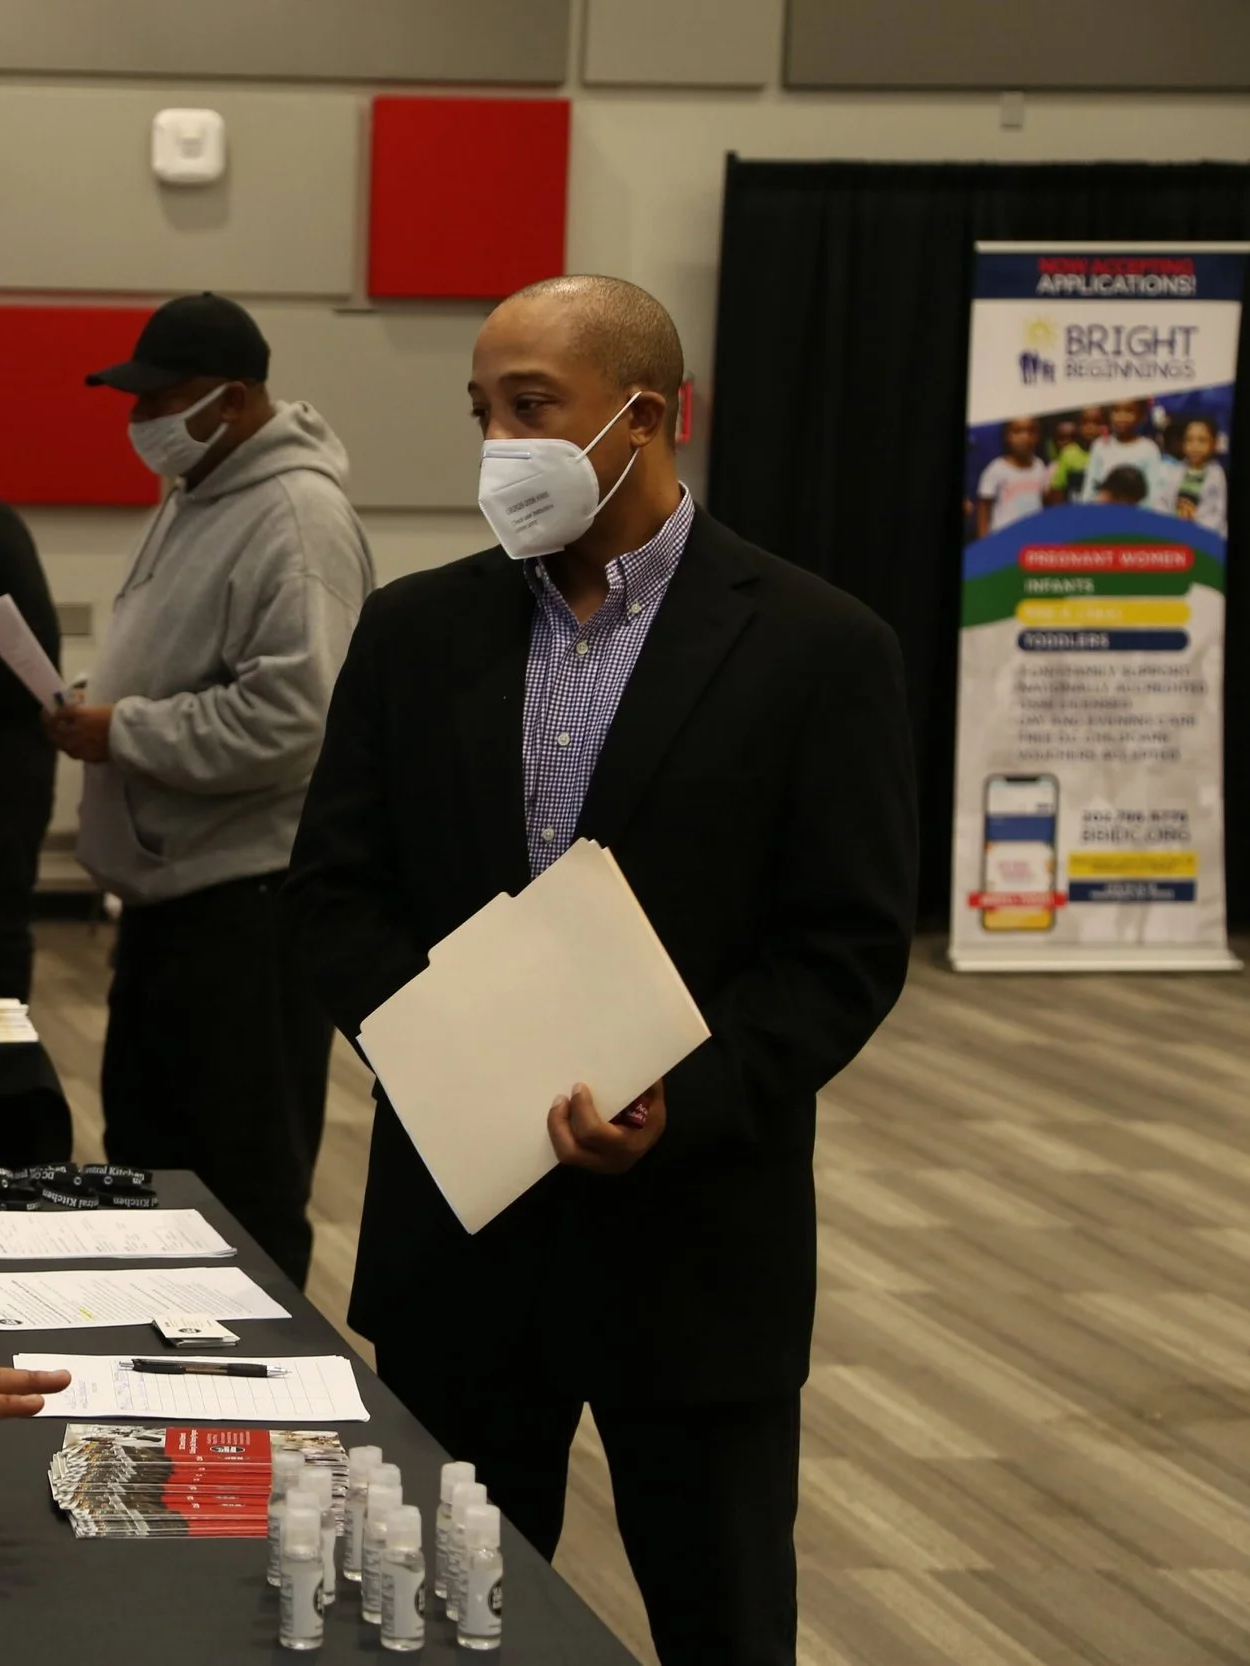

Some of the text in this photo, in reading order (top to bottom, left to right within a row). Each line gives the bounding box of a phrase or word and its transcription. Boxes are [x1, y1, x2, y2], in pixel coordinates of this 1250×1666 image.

[1037, 274, 1197, 296] APPLICATIONS!
[1065, 324, 1198, 357] BRIGHT
[1065, 358, 1196, 379] BEGINNINGS
[1025, 549, 1188, 568] PREGNANT WOMEN
[1024, 577, 1095, 594] INFANTS
[1024, 631, 1110, 650] TODDLERS
[108, 1166, 146, 1181] Kitchen
[42, 1188, 77, 1207] Kitchen
[112, 1196, 151, 1208] Kitchen
